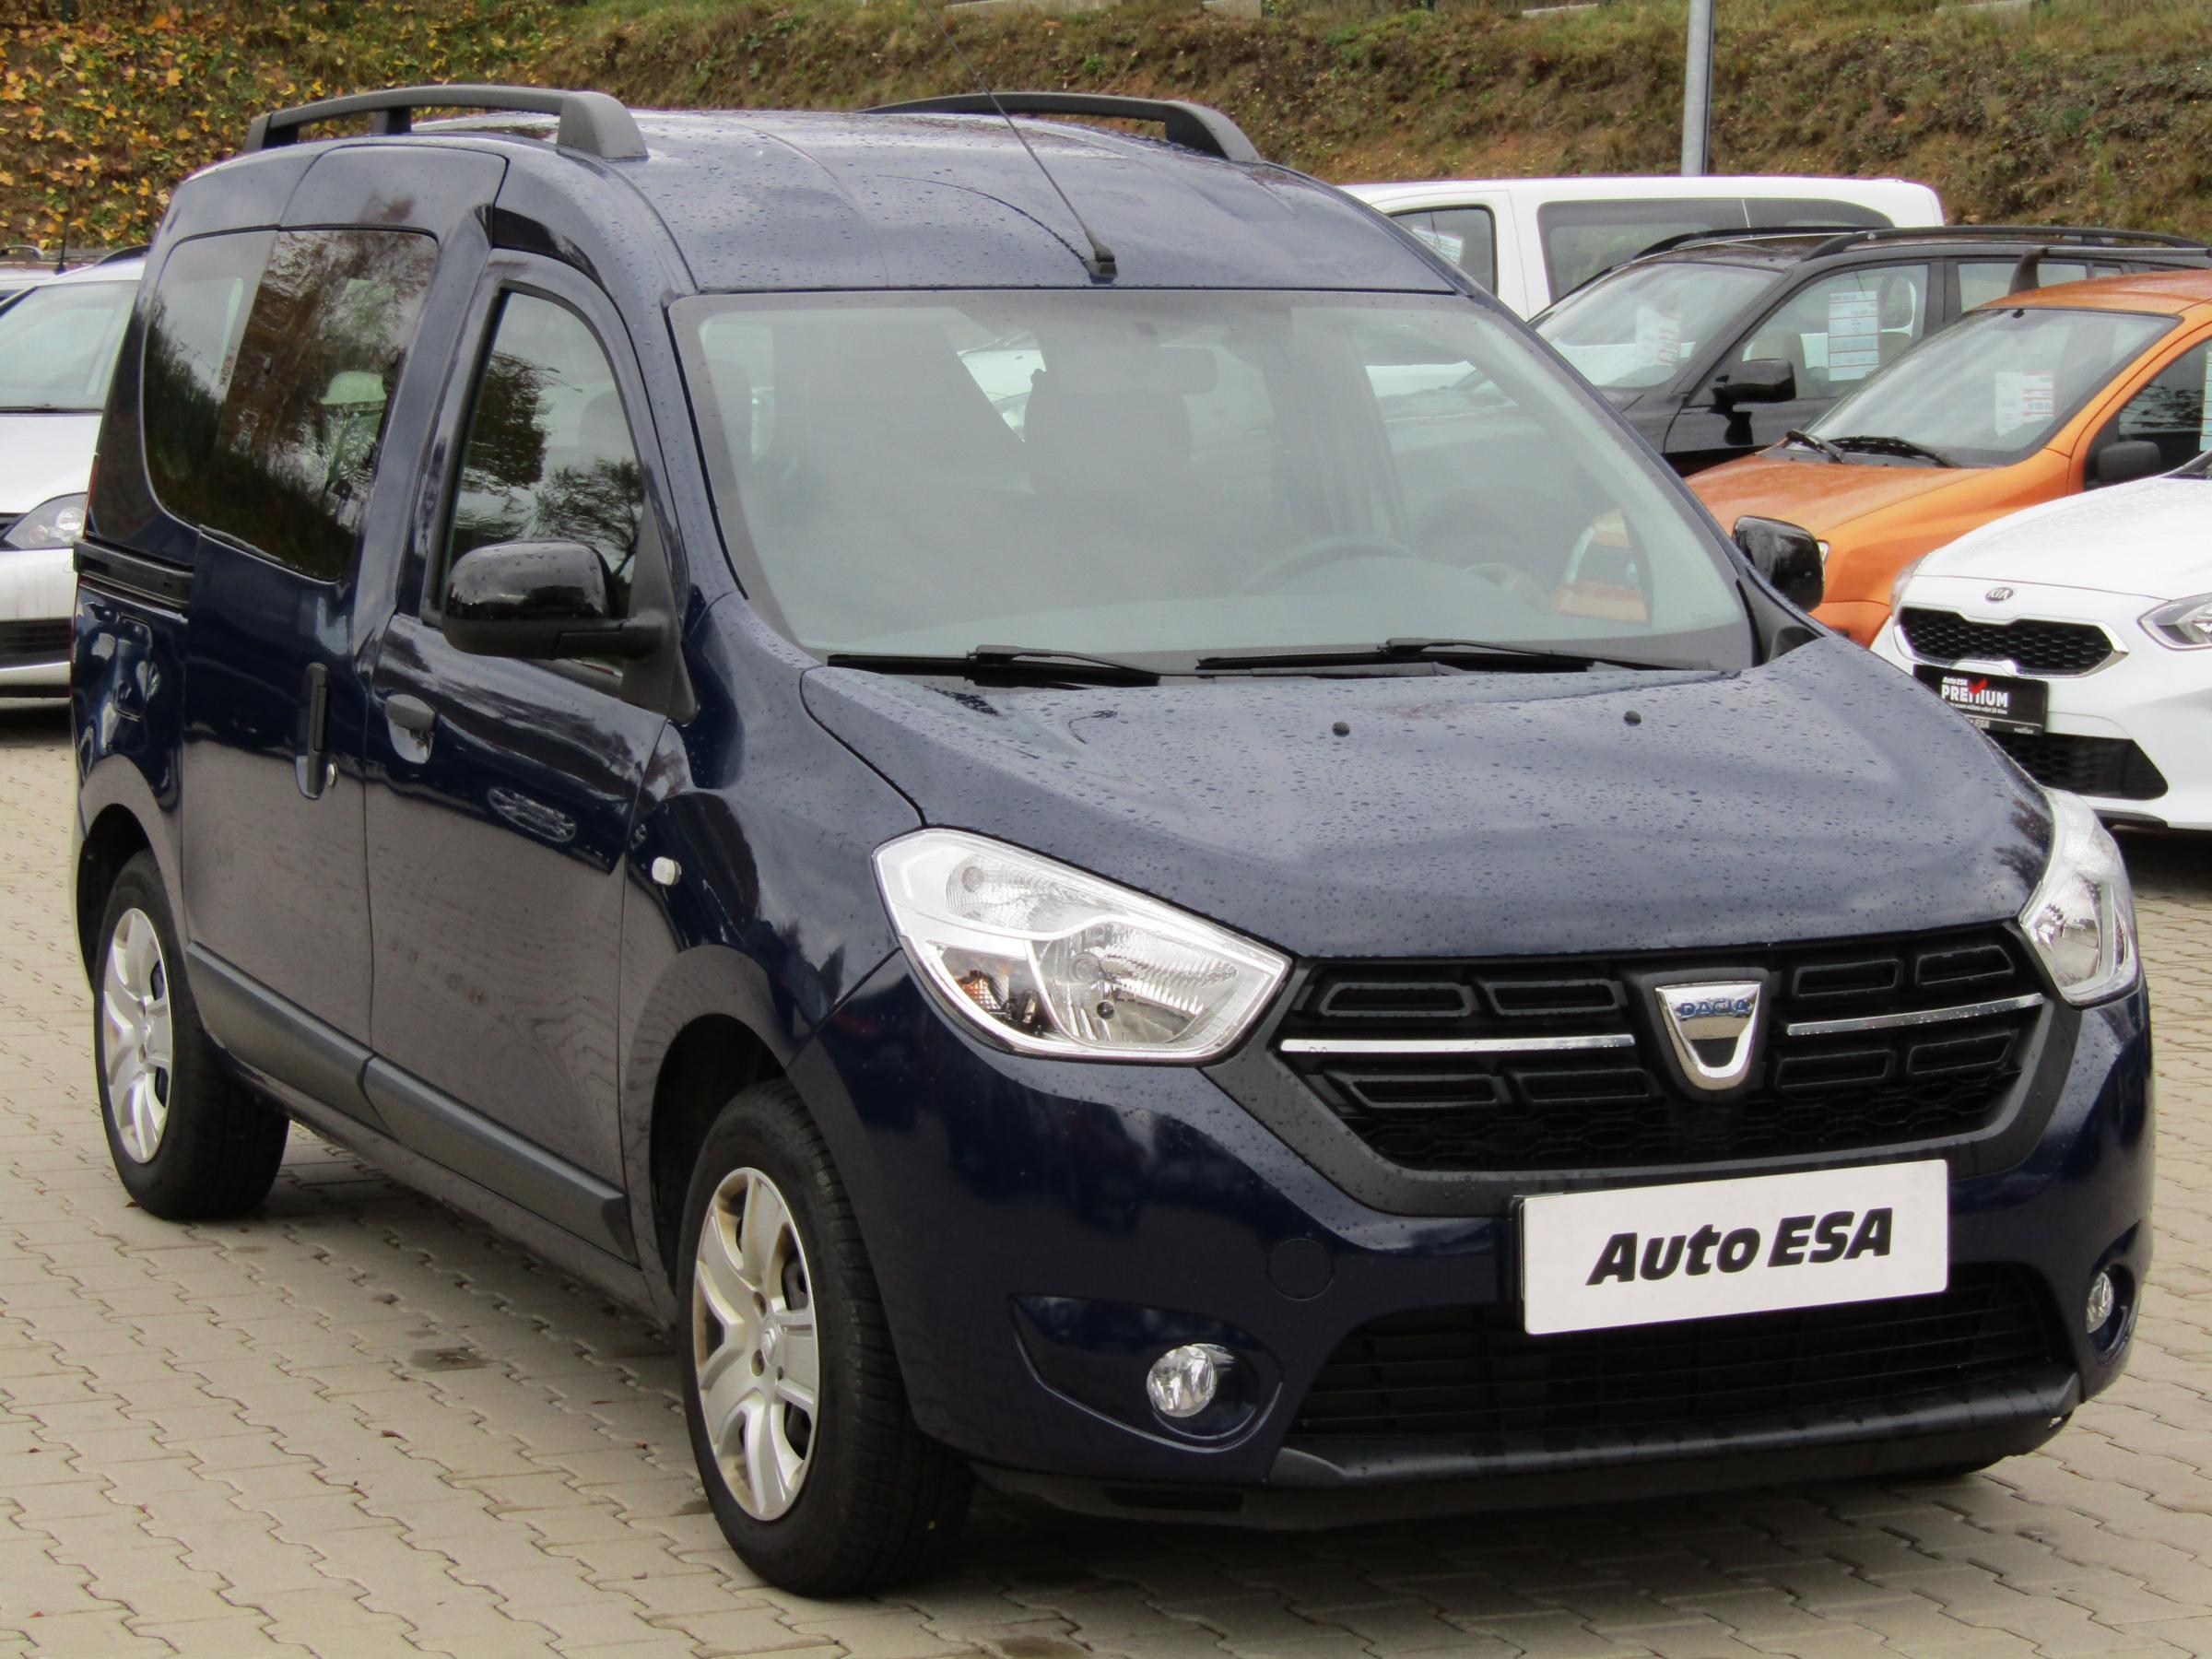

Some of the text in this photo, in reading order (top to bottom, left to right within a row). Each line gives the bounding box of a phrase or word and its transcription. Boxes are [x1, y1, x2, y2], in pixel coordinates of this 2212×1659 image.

[1989, 588, 2010, 600] KIA
[1941, 684, 2008, 708] PREMIUM
[1679, 998, 1750, 1018] DACIA
[1585, 1207, 1893, 1286] Auto ESA
